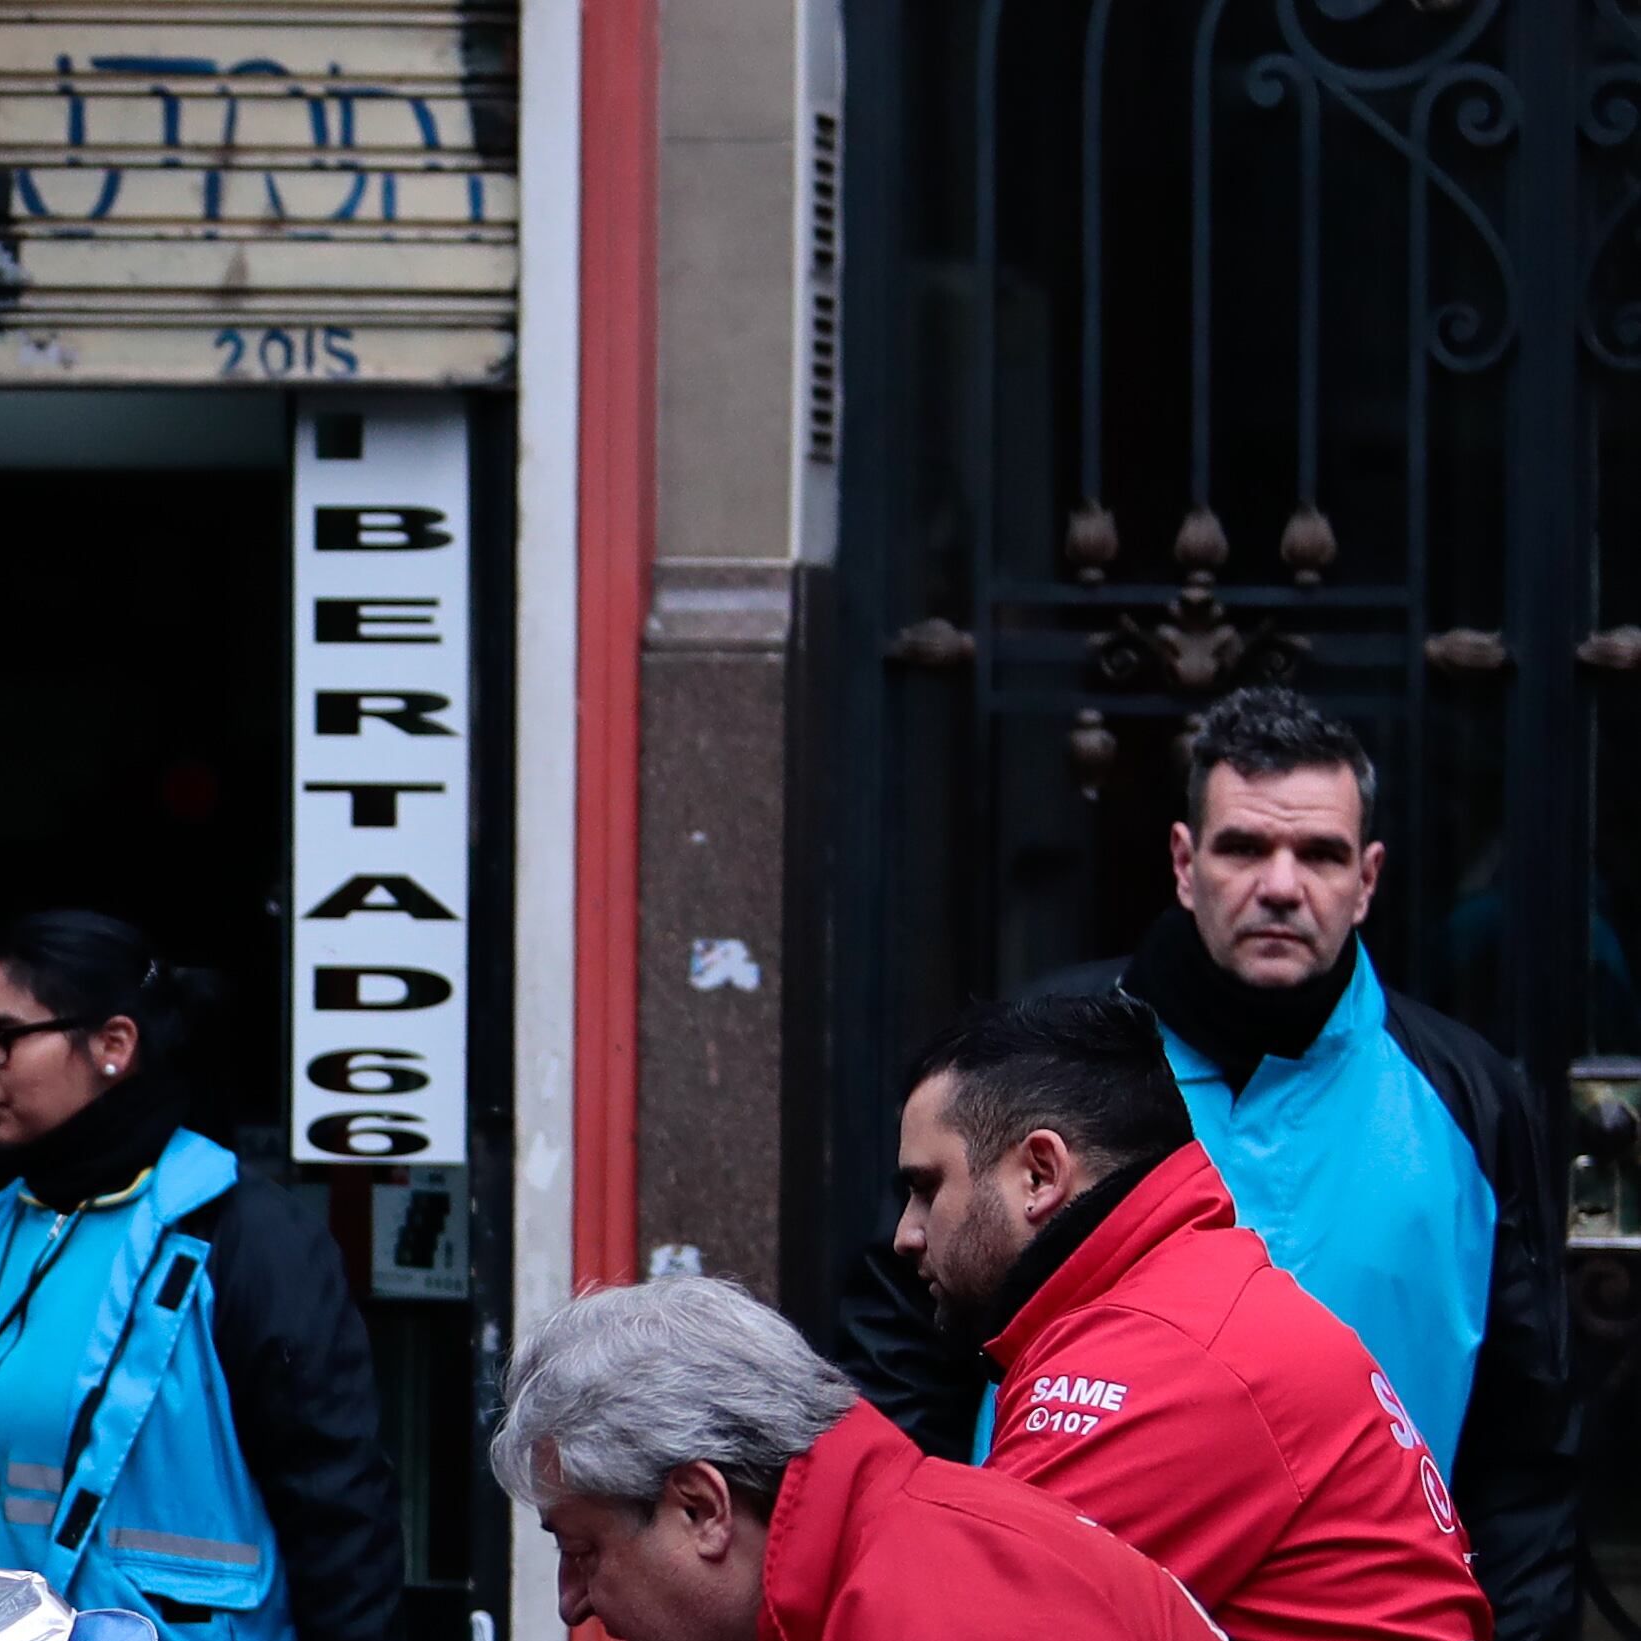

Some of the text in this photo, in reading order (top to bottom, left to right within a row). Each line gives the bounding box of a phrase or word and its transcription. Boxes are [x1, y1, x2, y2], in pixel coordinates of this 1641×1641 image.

[217, 326, 359, 379] 2015
[1030, 1375, 1128, 1412] SAME
[1049, 1410, 1099, 1436] 107
